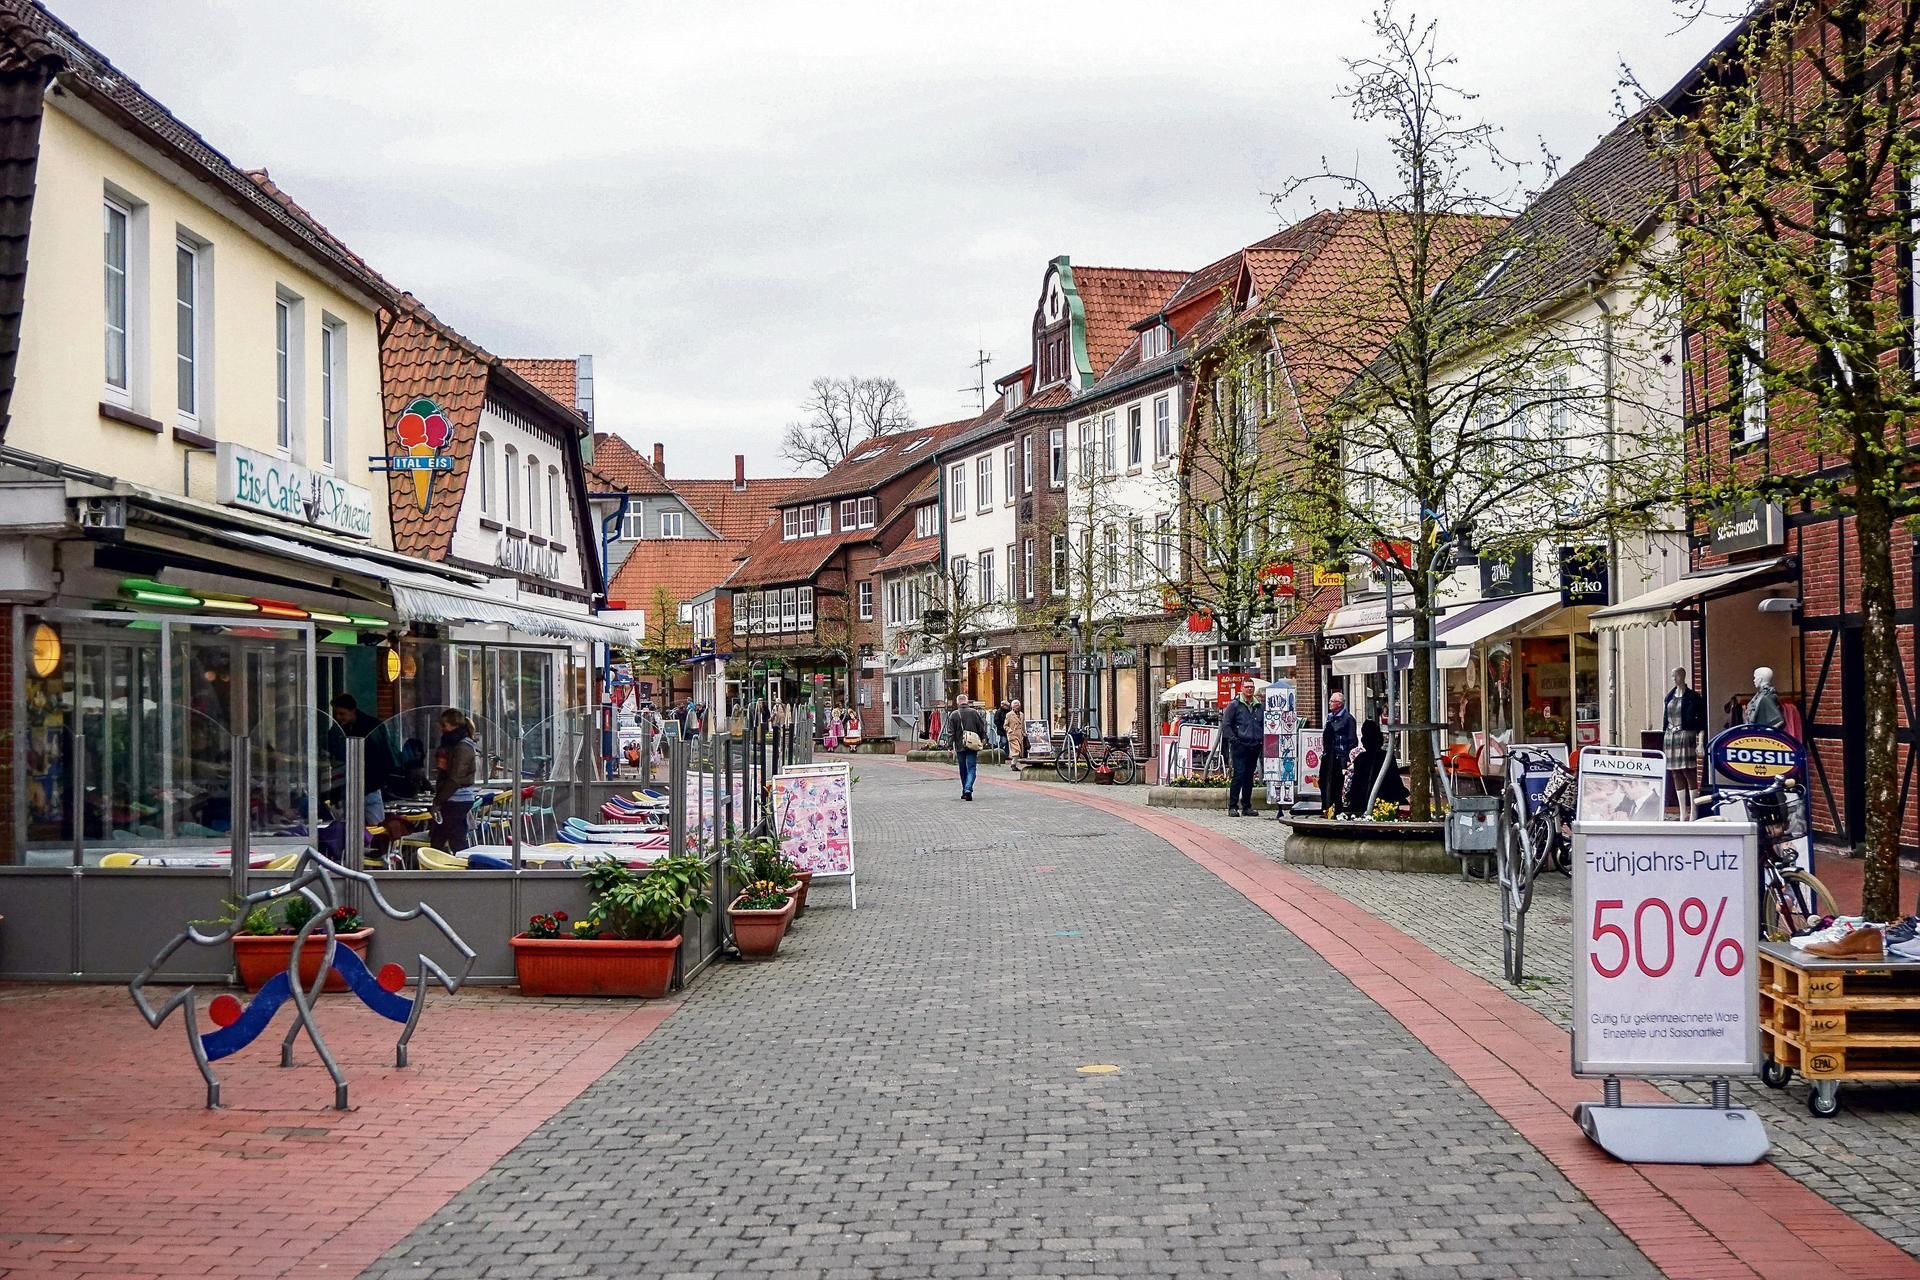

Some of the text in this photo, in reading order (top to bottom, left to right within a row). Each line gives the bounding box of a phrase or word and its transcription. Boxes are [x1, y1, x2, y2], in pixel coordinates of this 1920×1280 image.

[396, 458, 448, 469] ITAL EIS
[236, 456, 372, 533] Eis-Café Venezia
[1570, 577, 1602, 592] arko
[1192, 729, 1208, 749] Bild
[1734, 738, 1787, 749] AUTHENTIC
[1726, 749, 1795, 765] FOSSIL
[1593, 759, 1651, 771] PANDORA
[1590, 896, 1744, 979] 50%
[1591, 1012, 1739, 1026] Gültig für gekennzeichnete Ware
[1650, 1028, 1667, 1037] und
[1814, 1059, 1832, 1069] EPAL
